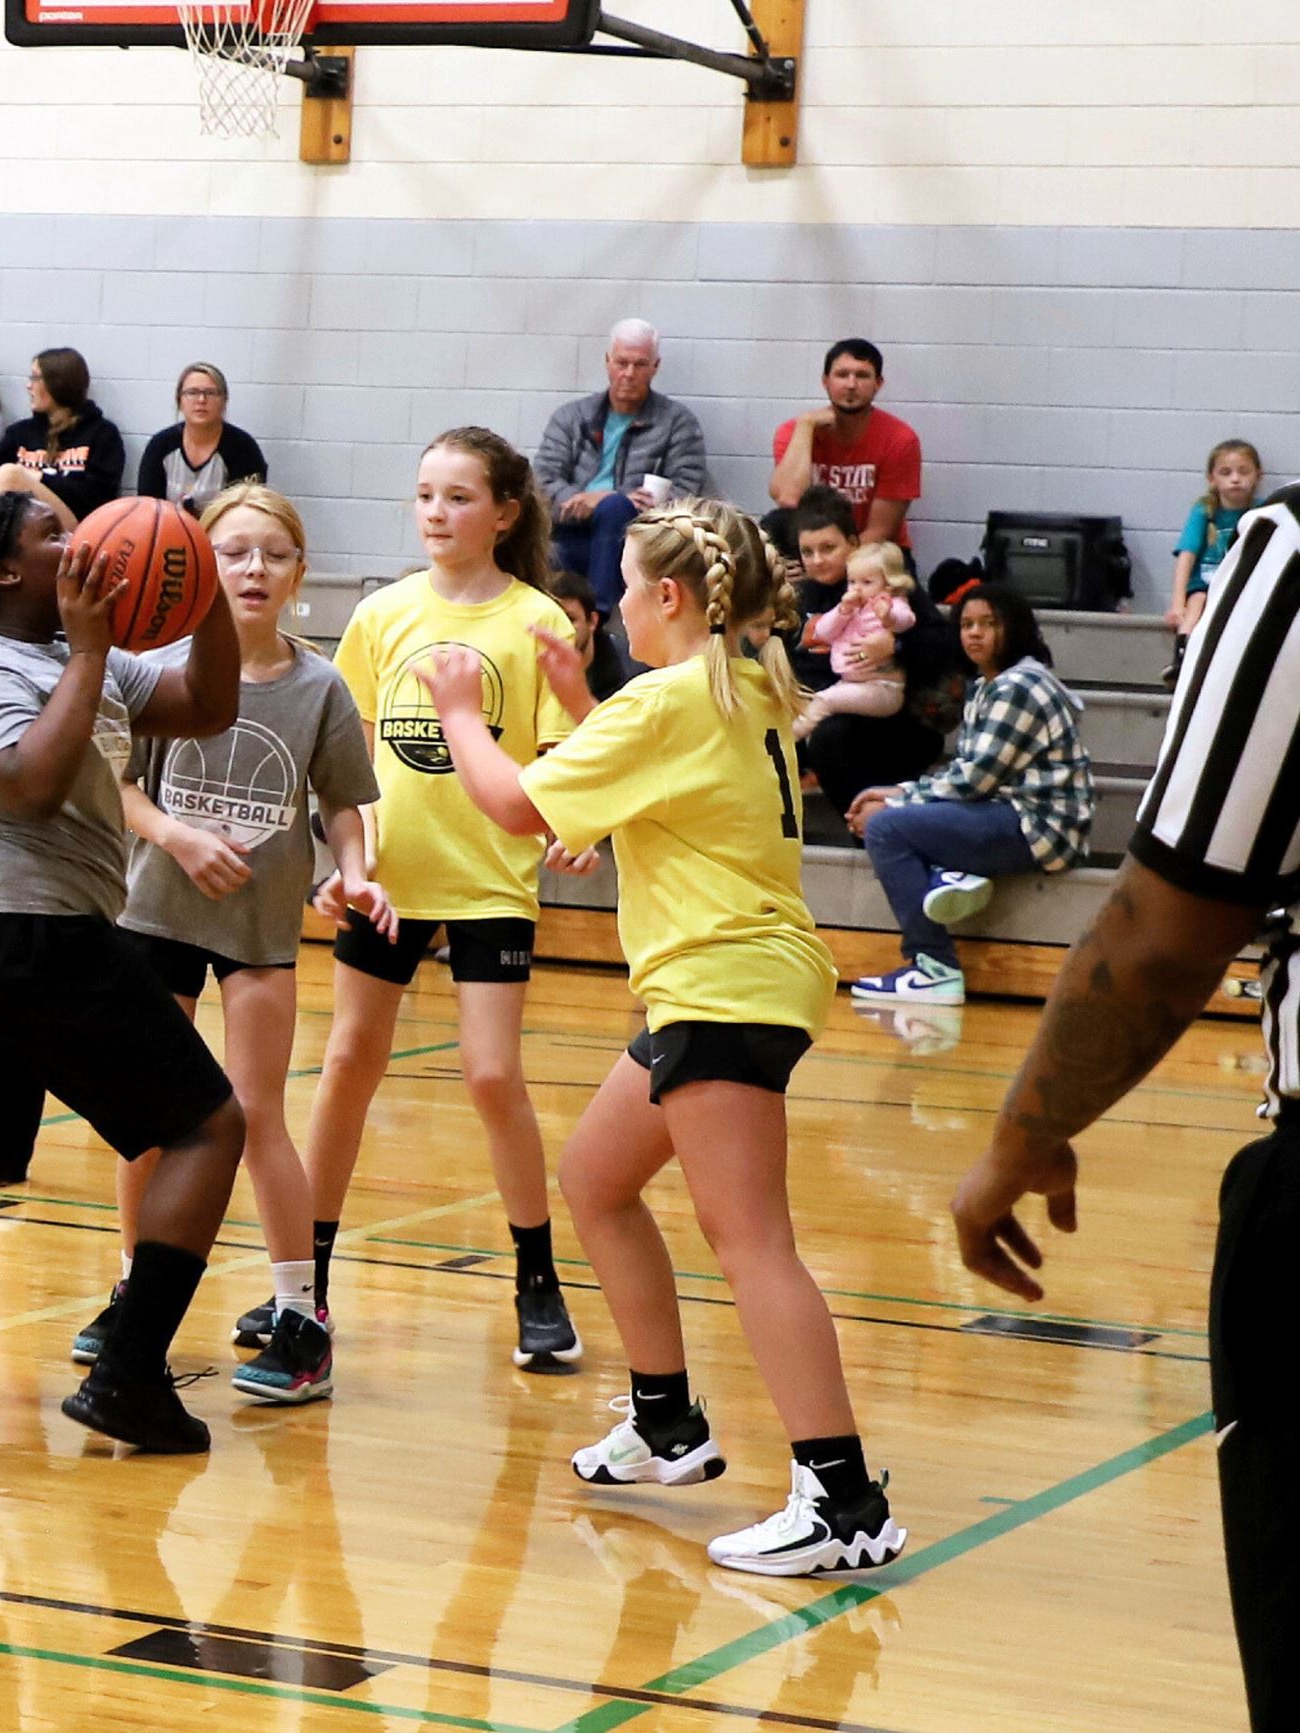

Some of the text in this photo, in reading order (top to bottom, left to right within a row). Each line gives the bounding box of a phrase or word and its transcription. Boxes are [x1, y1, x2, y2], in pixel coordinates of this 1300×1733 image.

[829, 464, 876, 488] STATE
[140, 547, 187, 640] Wilson
[164, 789, 289, 828] BASKETBALL
[764, 728, 799, 838] 1
